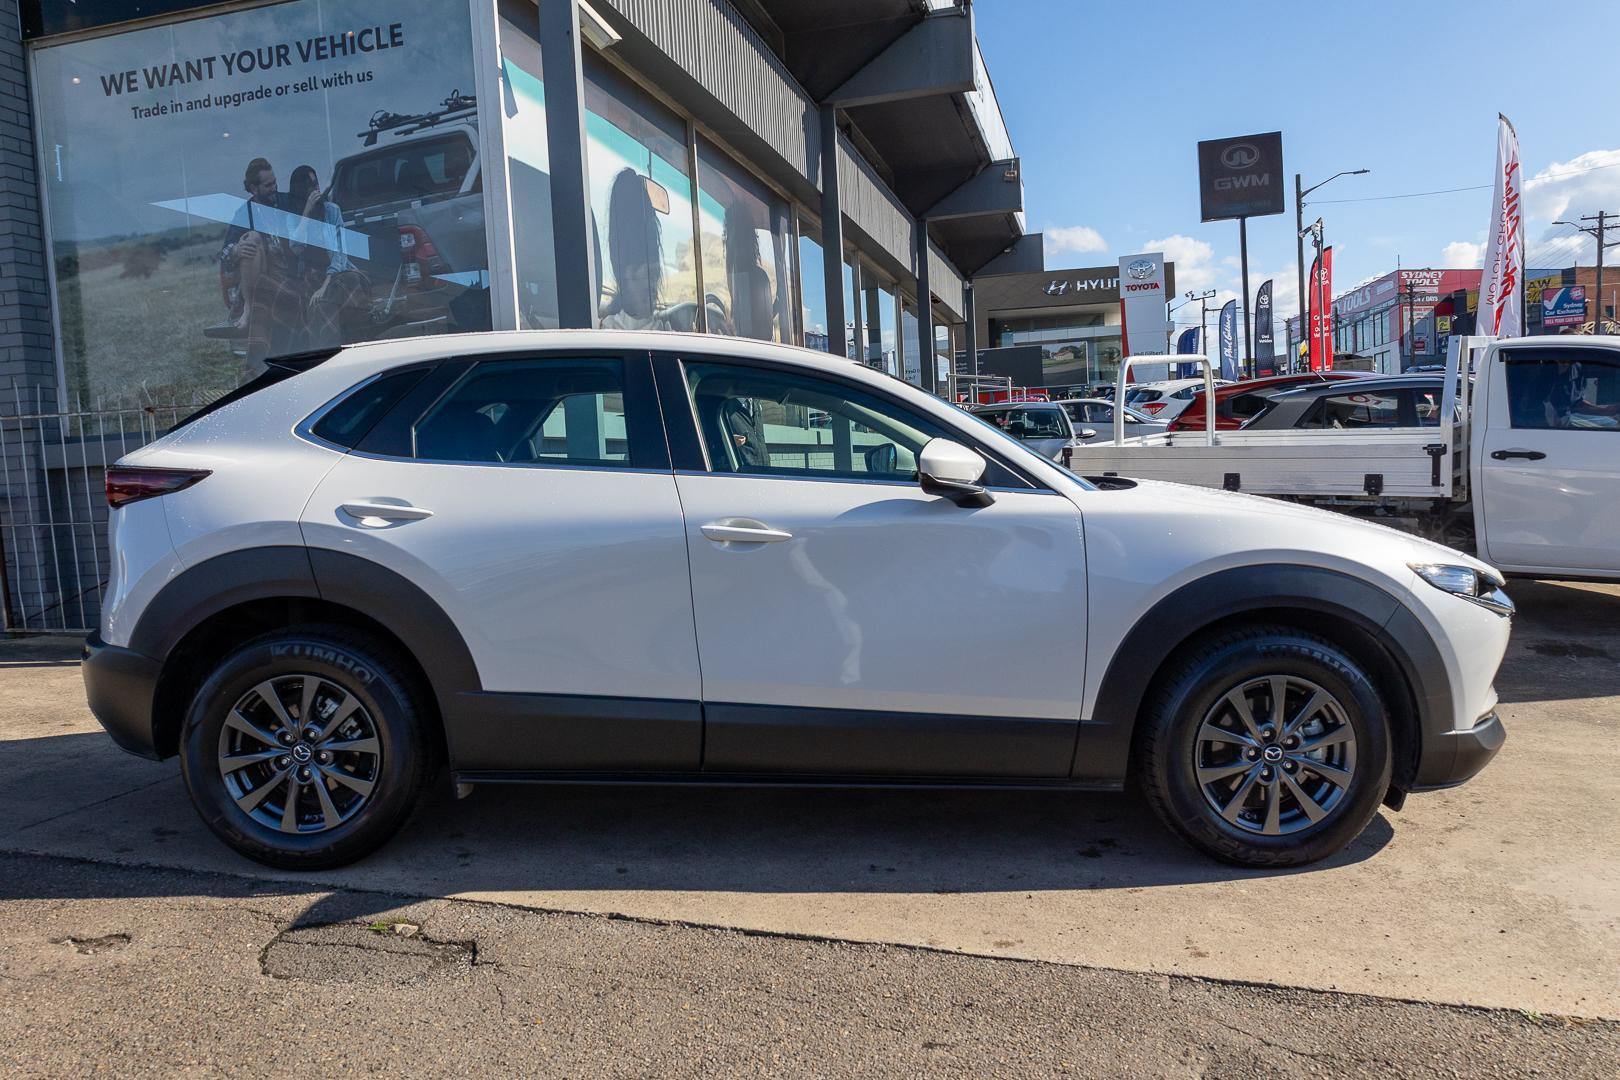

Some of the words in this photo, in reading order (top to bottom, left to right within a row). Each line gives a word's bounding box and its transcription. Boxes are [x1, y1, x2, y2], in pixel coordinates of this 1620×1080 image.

[100, 70, 139, 96] WE
[143, 56, 216, 89] WANT
[221, 43, 292, 76] YOUR
[295, 23, 404, 63] VEHICLE
[131, 102, 168, 119] Trade
[170, 100, 183, 113] in
[186, 94, 211, 111] and
[214, 85, 272, 109] upgrade
[275, 84, 290, 96] or
[293, 76, 319, 93] sell
[321, 70, 353, 88] with
[356, 70, 373, 82] us
[1213, 173, 1270, 190] GWM
[1401, 271, 1445, 279] SYDNEY
[1405, 278, 1440, 286] TOOLS
[1125, 282, 1160, 292] TOYOTA
[1343, 287, 1371, 314] TOOLS
